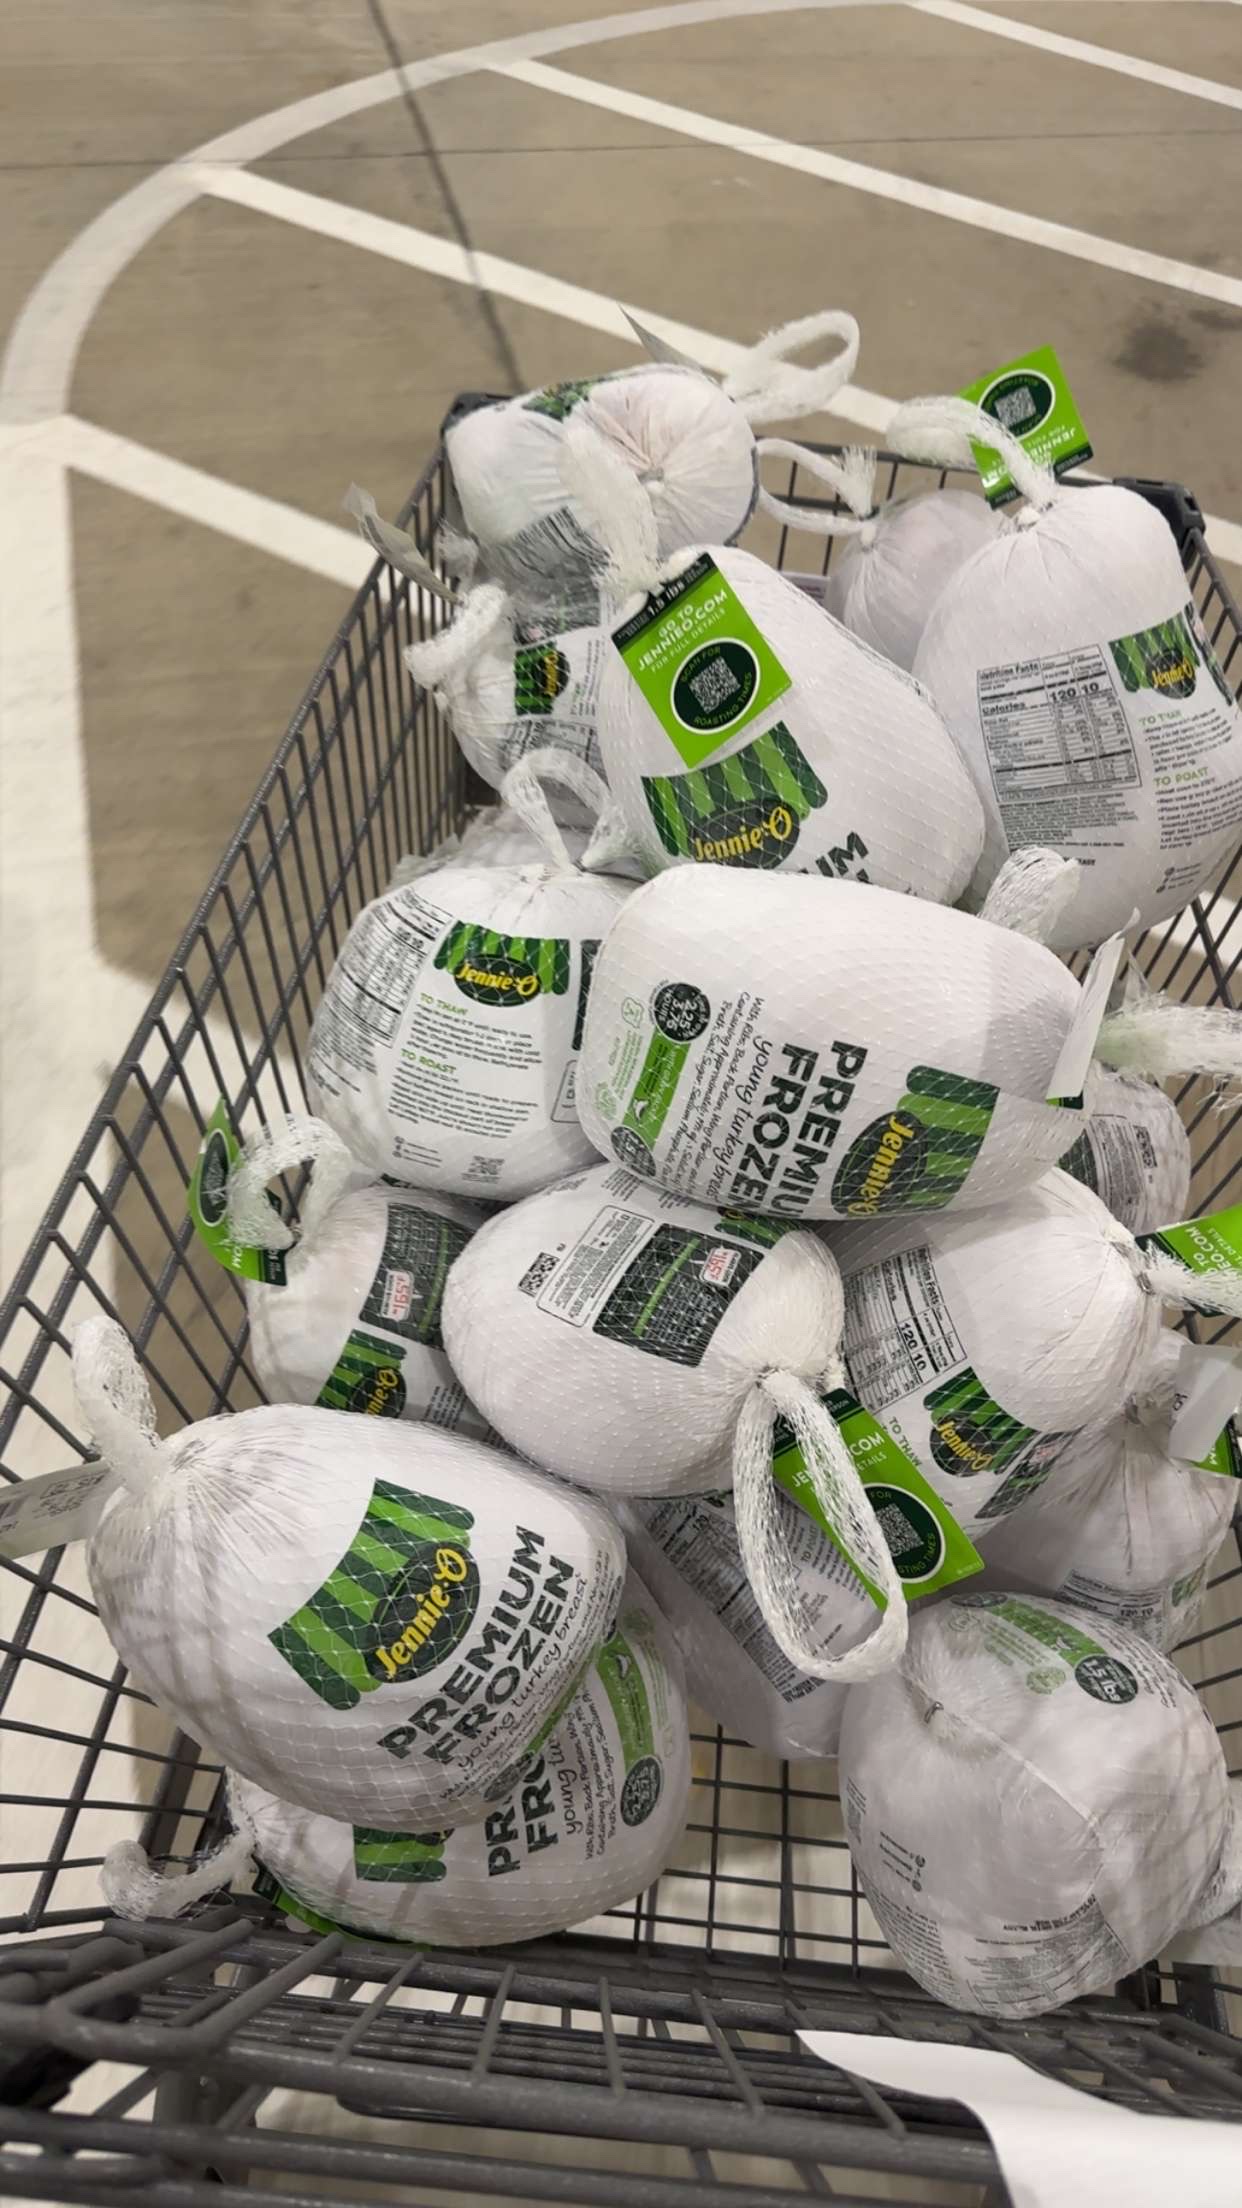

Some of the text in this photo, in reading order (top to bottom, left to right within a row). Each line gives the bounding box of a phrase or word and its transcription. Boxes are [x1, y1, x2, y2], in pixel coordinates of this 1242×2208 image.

[639, 589, 728, 671] JENNIEO.COM
[659, 620, 676, 638] GO
[677, 604, 693, 620] TO
[1050, 682, 1100, 703] 120 10
[1153, 776, 1171, 788] TO
[401, 1048, 417, 1061] TO
[731, 1034, 775, 1106] young
[709, 1104, 755, 1167] turkey
[926, 1280, 939, 1305] Facts
[899, 1321, 927, 1371] 120 10
[886, 1416, 903, 1435] TO
[373, 1548, 471, 1677] Jennie-O
[376, 1524, 546, 1759] PREMIUM
[422, 1555, 575, 1765] FROZEN
[457, 1710, 515, 1771] young
[509, 1639, 563, 1708] turkey
[551, 1571, 591, 1641] breast
[1100, 1678, 1121, 1702] lbs
[556, 1768, 582, 1833] young
